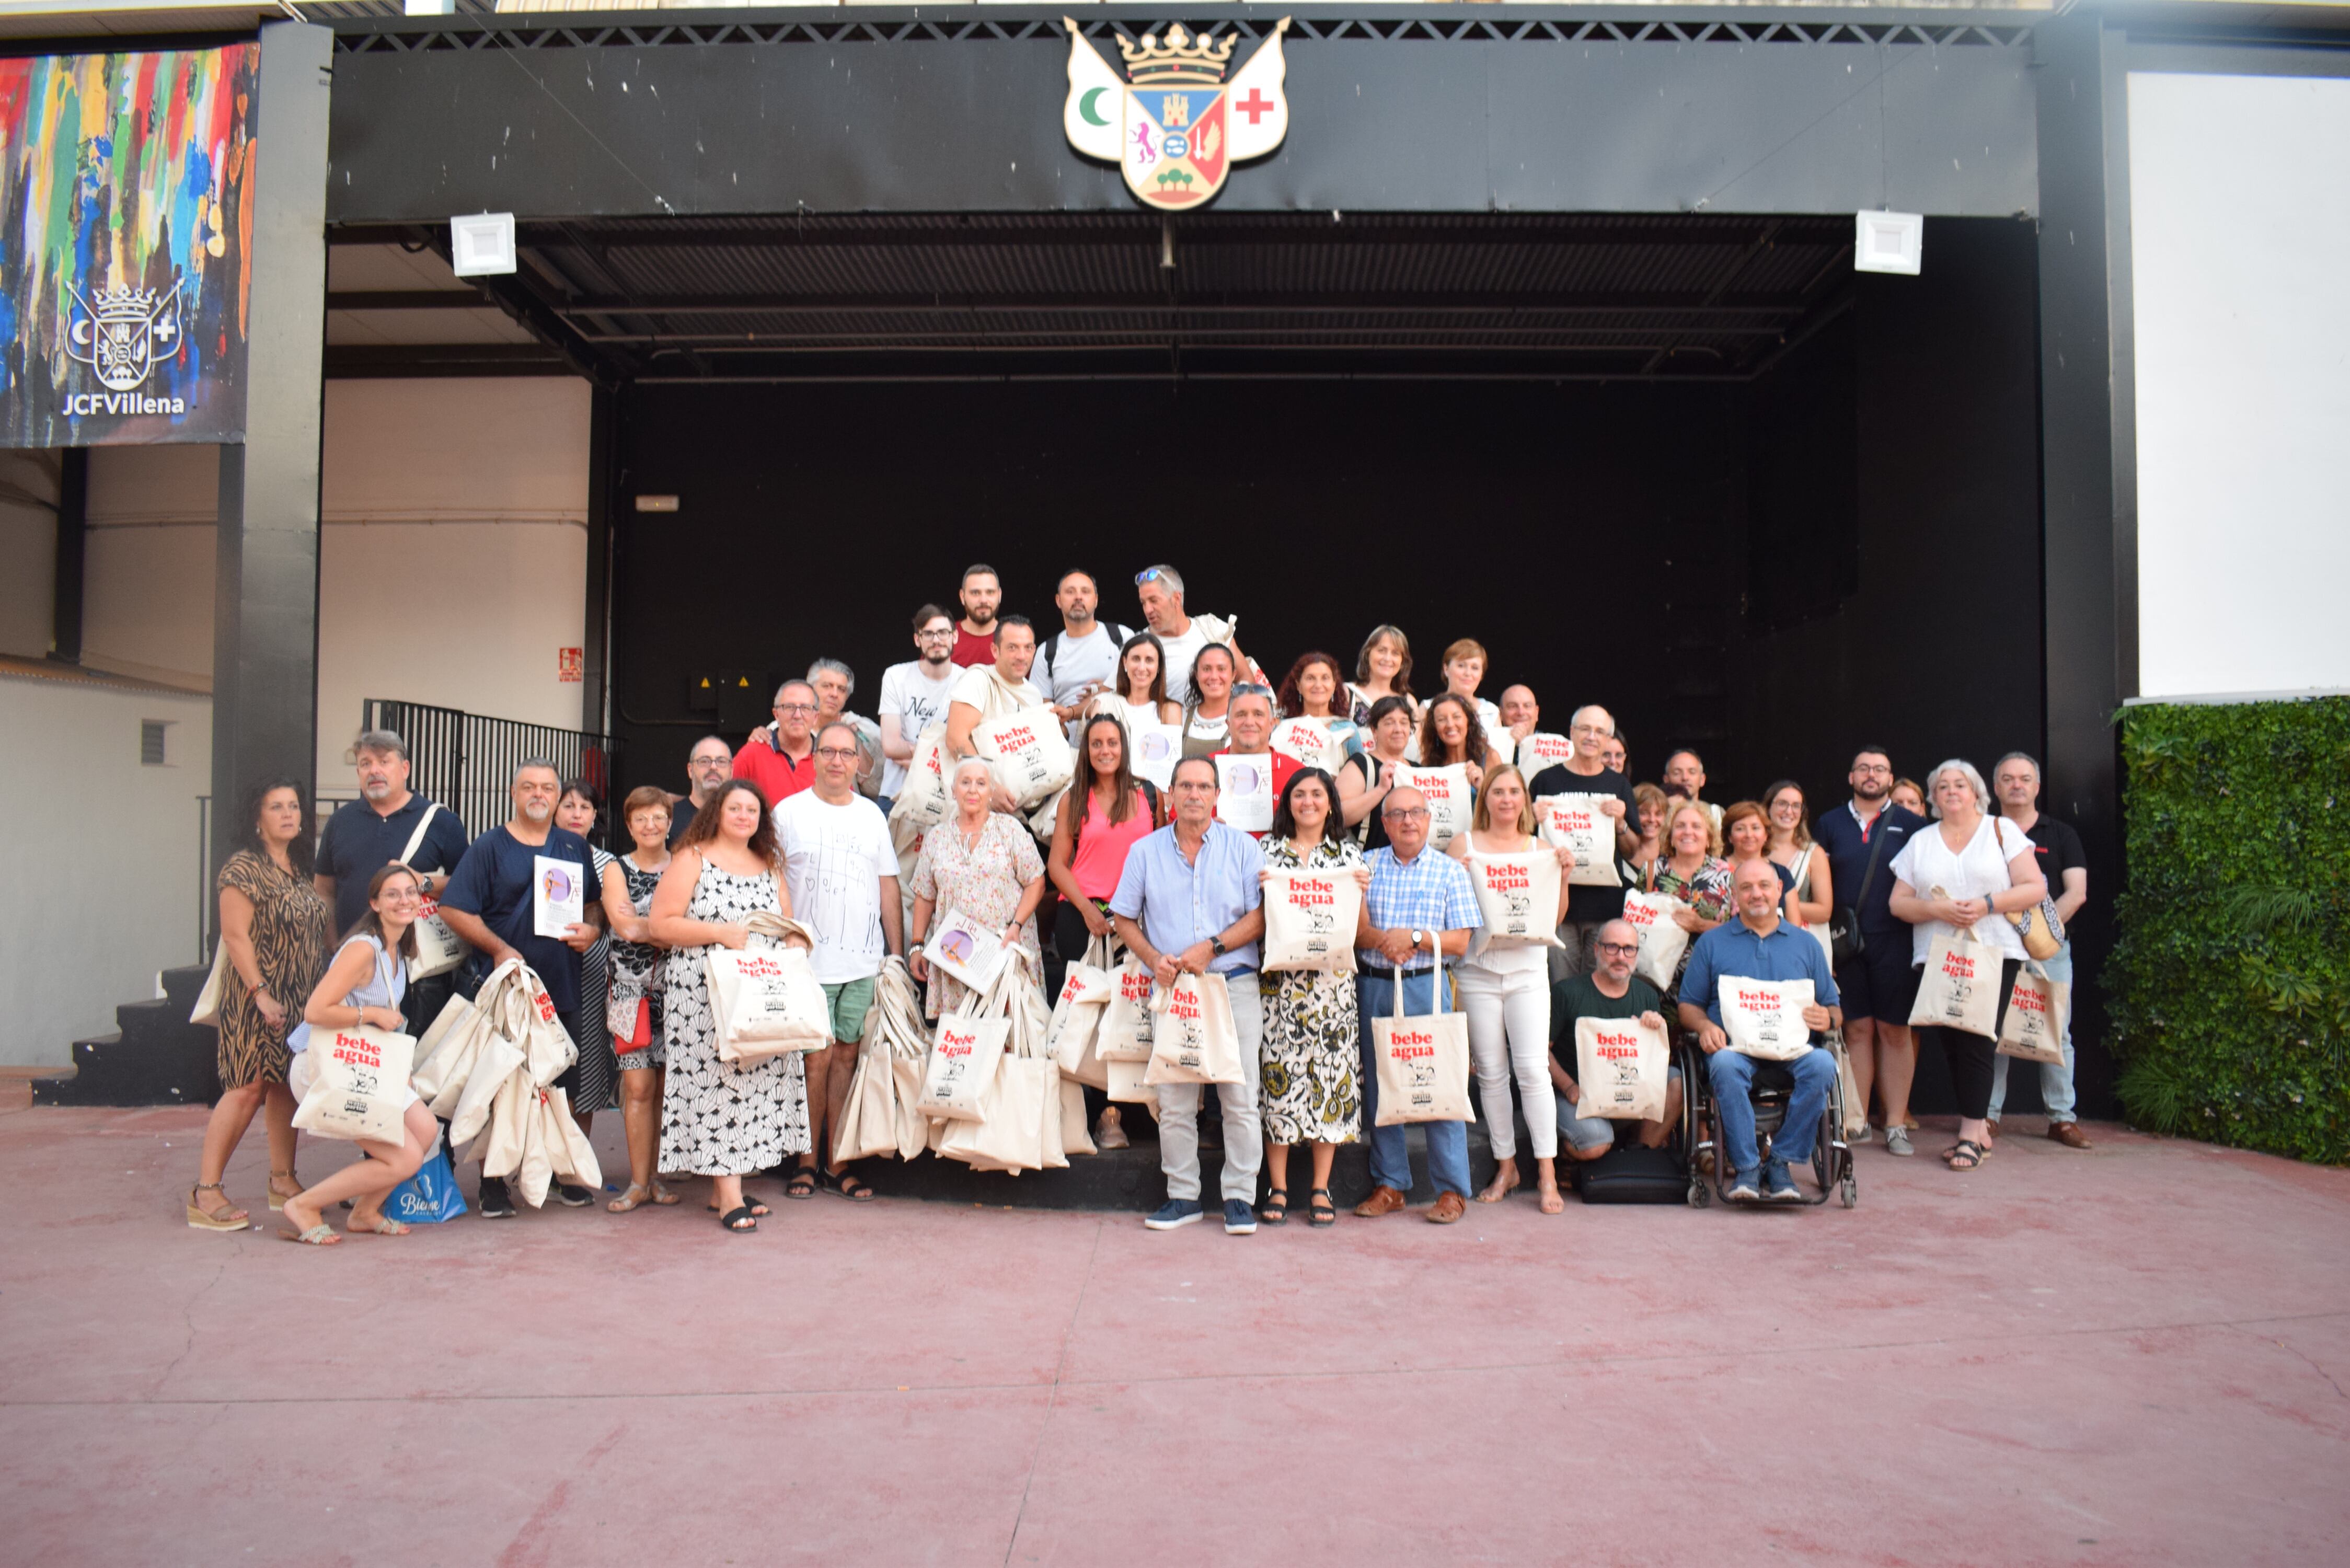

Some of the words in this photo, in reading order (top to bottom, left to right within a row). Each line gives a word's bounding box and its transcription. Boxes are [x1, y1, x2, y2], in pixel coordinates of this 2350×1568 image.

[63, 393, 184, 416] JCFVillena
[905, 696, 938, 717] New
[994, 725, 1031, 744] bebe
[999, 734, 1036, 753] agua
[1536, 737, 1569, 748] bebe
[1534, 747, 1569, 757] agua
[1413, 775, 1448, 787] bebe
[1422, 788, 1450, 800] gua
[1553, 811, 1591, 821] bebe
[1554, 822, 1592, 833] agua
[1485, 863, 1528, 877] bebe
[1289, 878, 1333, 893] bebe
[1487, 877, 1529, 892] agua
[1289, 894, 1334, 908] agua
[1625, 900, 1658, 918] bebe
[1831, 926, 1847, 940] ILA
[736, 957, 778, 968] bebe
[739, 967, 782, 977] agua
[1121, 987, 1150, 1001] agu
[1173, 988, 1199, 1005] beb
[1739, 990, 1780, 1002] bebe
[2014, 984, 2046, 1002] bebe
[1740, 1002, 1781, 1011] agua
[2011, 999, 2046, 1012] agua
[336, 1033, 382, 1055] bebe
[1390, 1031, 1433, 1045] bebe
[1597, 1032, 1638, 1046] bebe
[333, 1048, 381, 1068] agua
[1390, 1046, 1434, 1061] agua
[1597, 1046, 1638, 1060] agua
